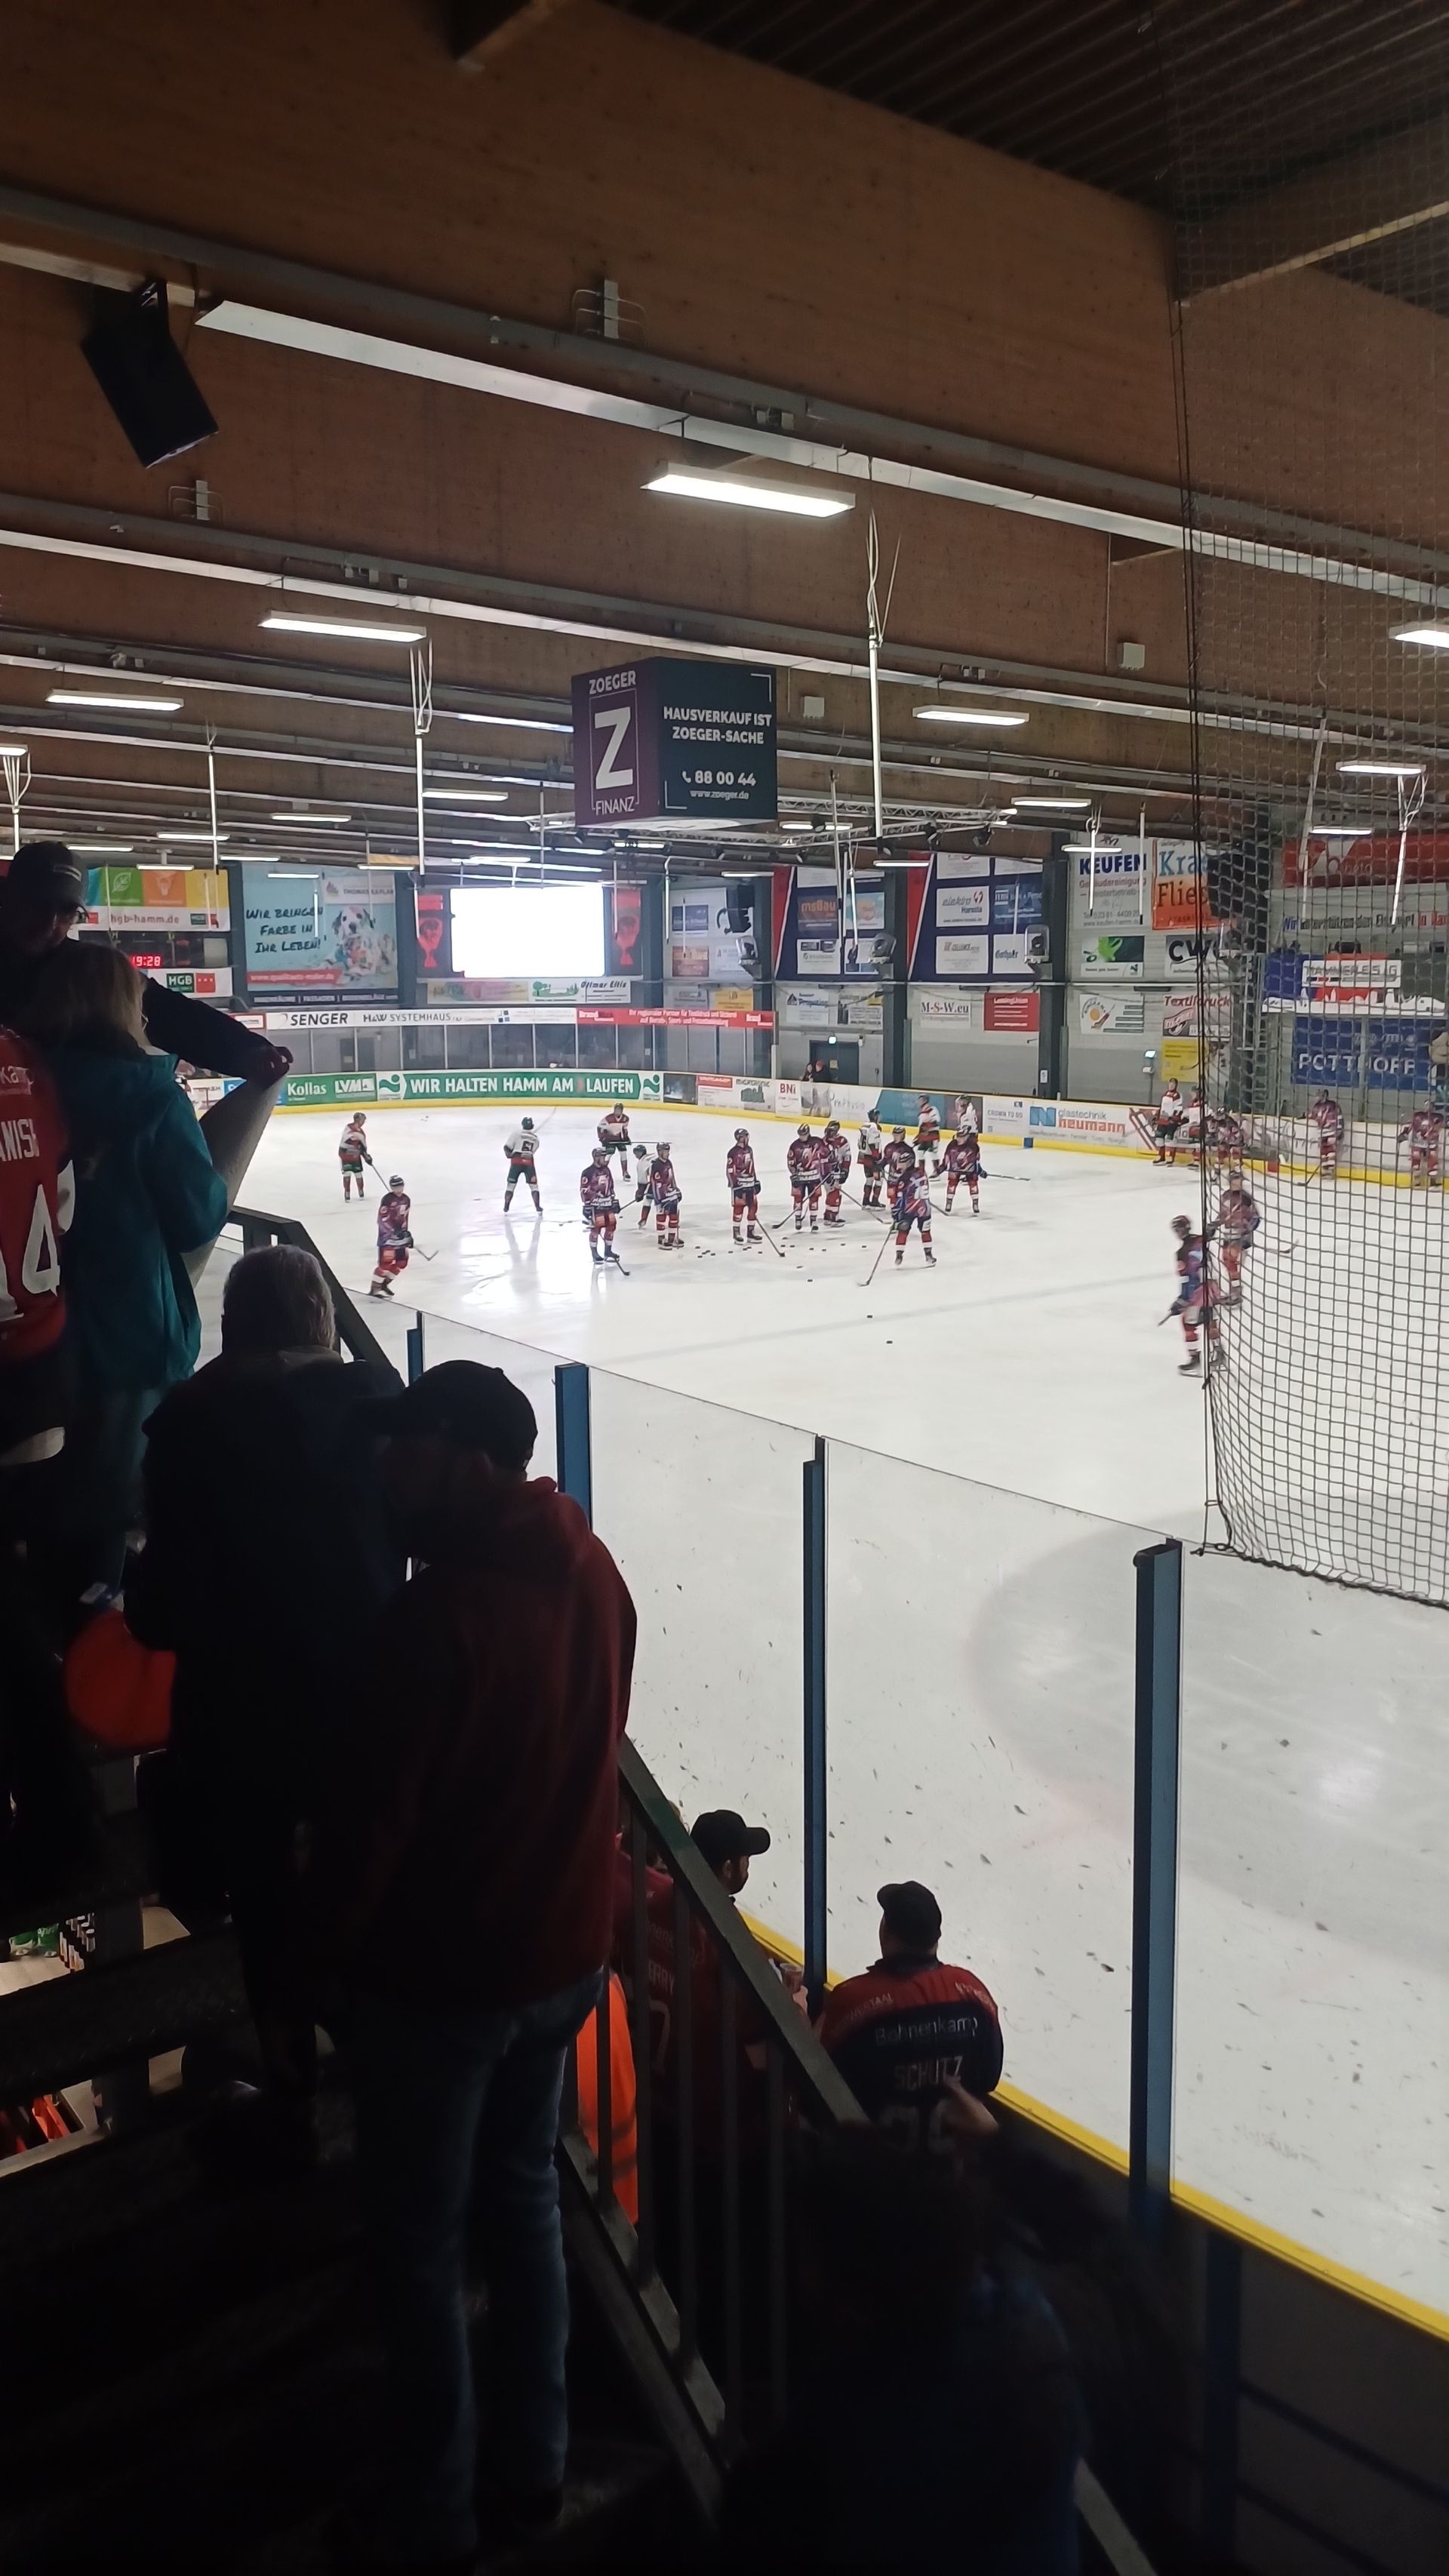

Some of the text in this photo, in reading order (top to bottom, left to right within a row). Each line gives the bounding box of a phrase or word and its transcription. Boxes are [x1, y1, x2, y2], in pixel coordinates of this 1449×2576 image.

[589, 670, 636, 694] ZOEGER
[663, 706, 772, 727] HAUSVERKAUF IST
[672, 726, 764, 744] ZOEGER-SACHE
[594, 706, 633, 789] Z
[695, 771, 756, 786] 88 00 44
[690, 789, 749, 801] www.zoeger.de
[595, 796, 635, 815] FINANZ
[1080, 854, 1146, 875] KEUFEN
[110, 914, 180, 925] hgb-hamm.de
[246, 906, 324, 919] WIR BRINGEN
[260, 925, 297, 936] FARBE
[255, 940, 321, 953] IHR LEBEN!
[168, 976, 192, 986] HGB
[921, 1002, 969, 1013] M-S-W.eu
[291, 1013, 348, 1026] SENGER
[389, 1013, 451, 1022] SYSTEMHAUS
[288, 1082, 326, 1096] Kollas
[334, 1079, 361, 1093] LVM
[410, 1077, 634, 1094] WIR HALTEN HAMM AM LAUFEN
[1058, 1109, 1106, 1120] glastechnik
[1059, 1118, 1125, 1134] neumann
